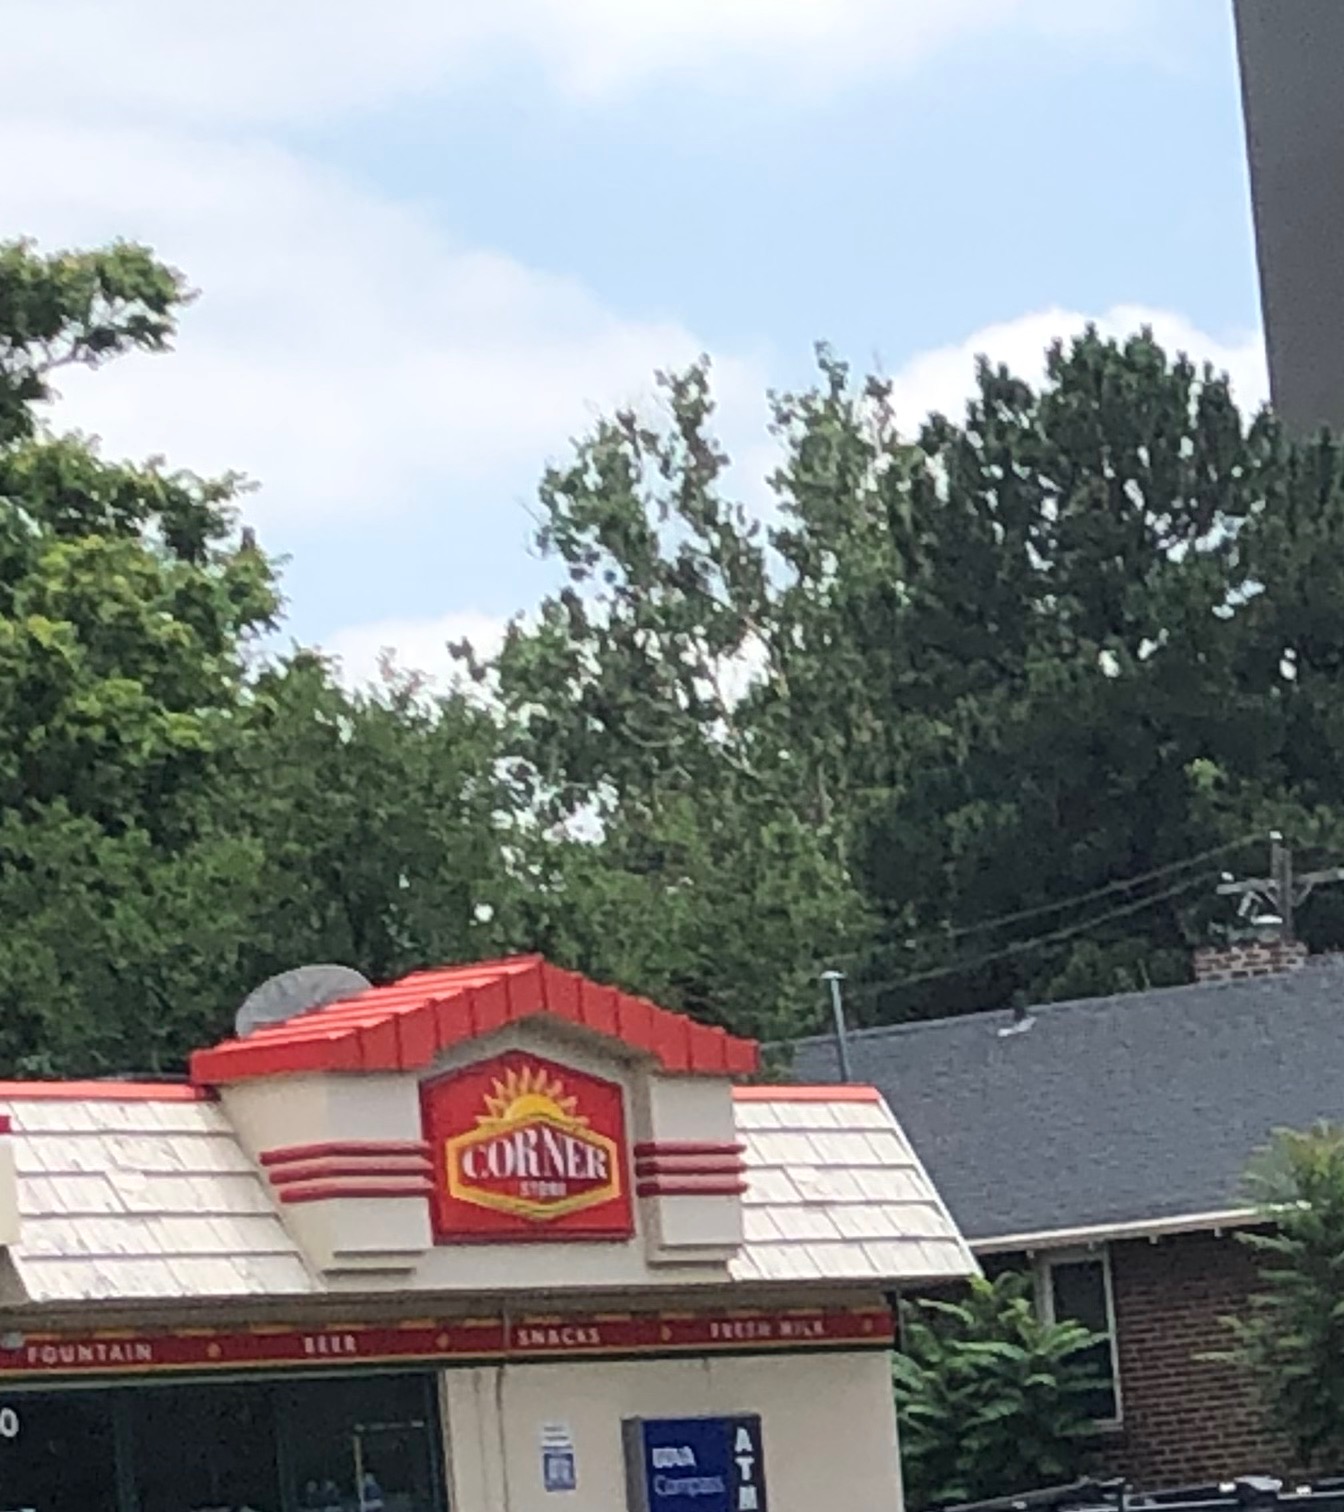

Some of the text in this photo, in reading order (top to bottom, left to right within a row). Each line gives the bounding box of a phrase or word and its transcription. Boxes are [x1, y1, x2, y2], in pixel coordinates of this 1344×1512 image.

[461, 1126, 608, 1179] CORNER
[517, 1326, 600, 1346] SNACKS
[27, 1343, 152, 1364] FOUNTAIN
